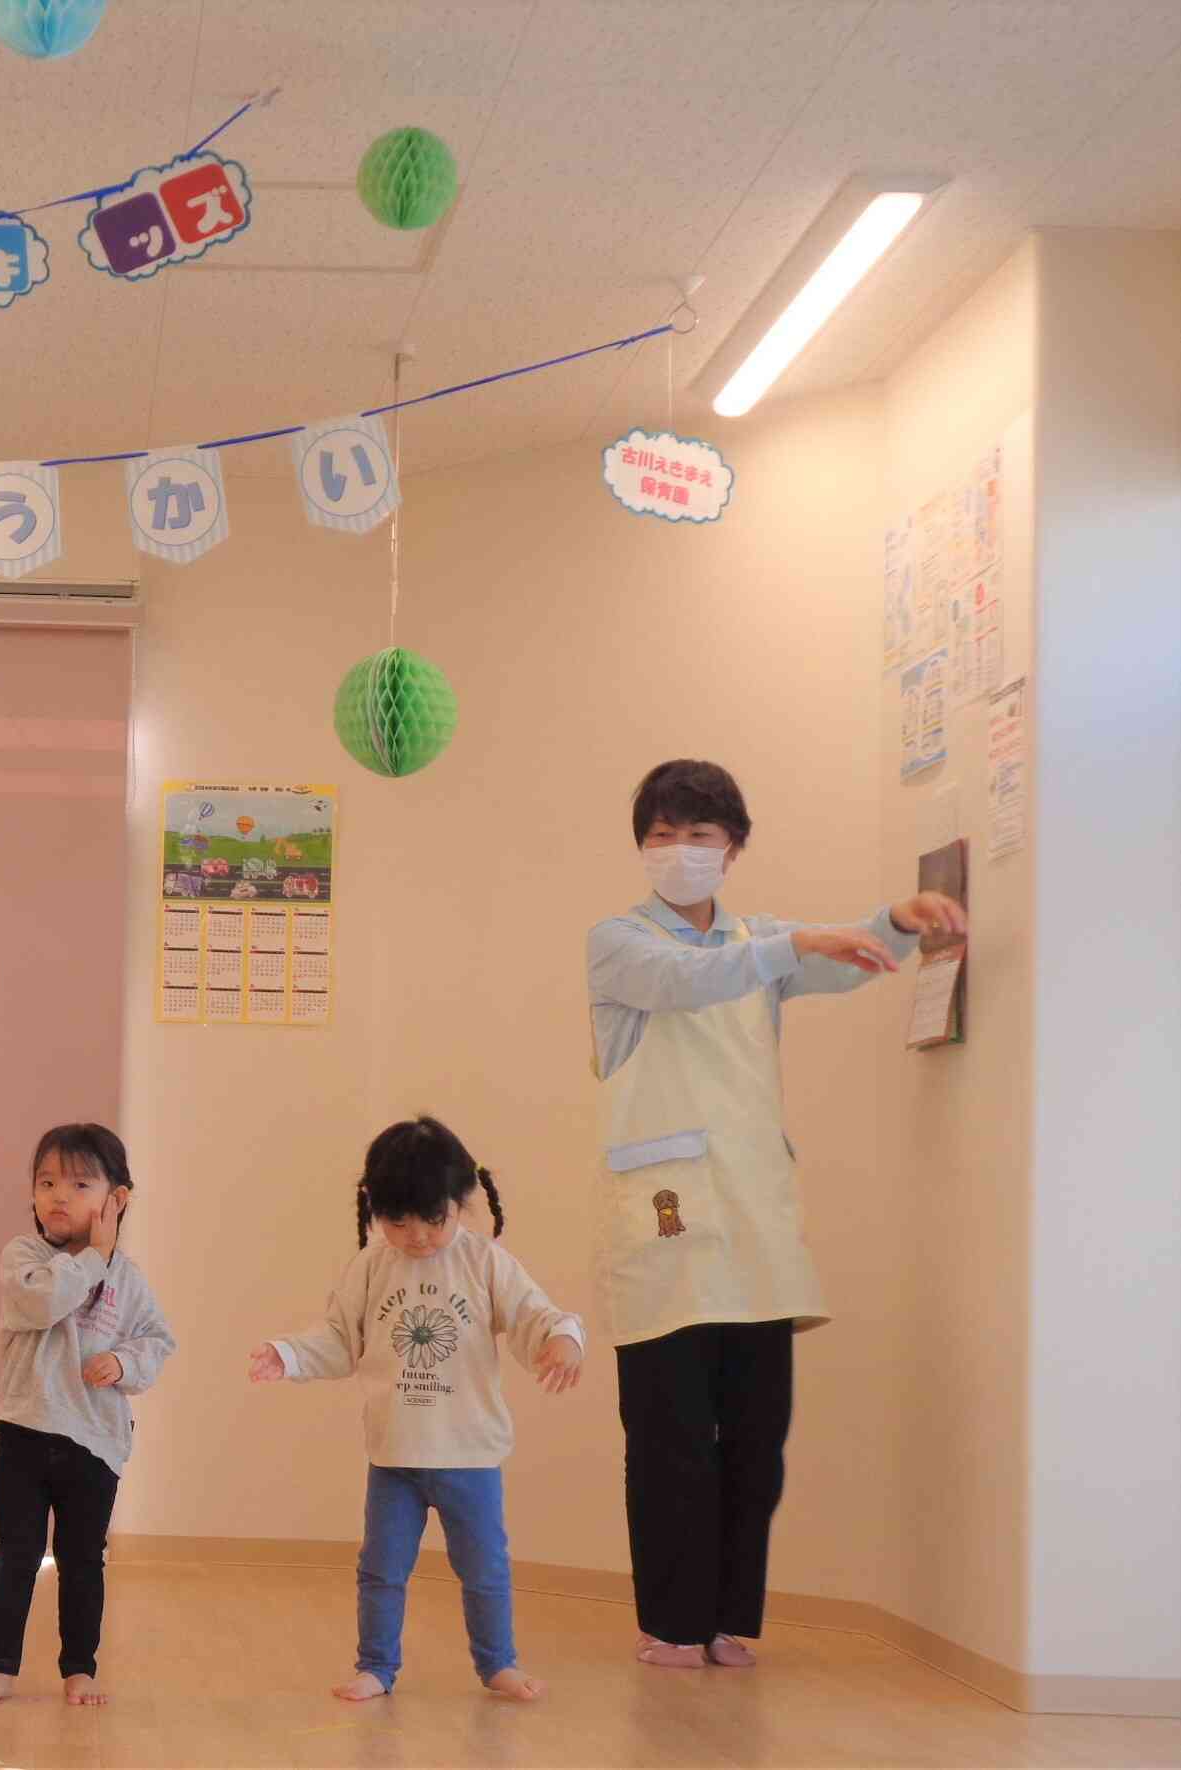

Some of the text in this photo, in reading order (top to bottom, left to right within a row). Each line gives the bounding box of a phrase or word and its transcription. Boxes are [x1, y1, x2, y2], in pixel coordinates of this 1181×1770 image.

[621, 446, 713, 487] 古川えきまえ
[377, 1282, 472, 1325] step to the
